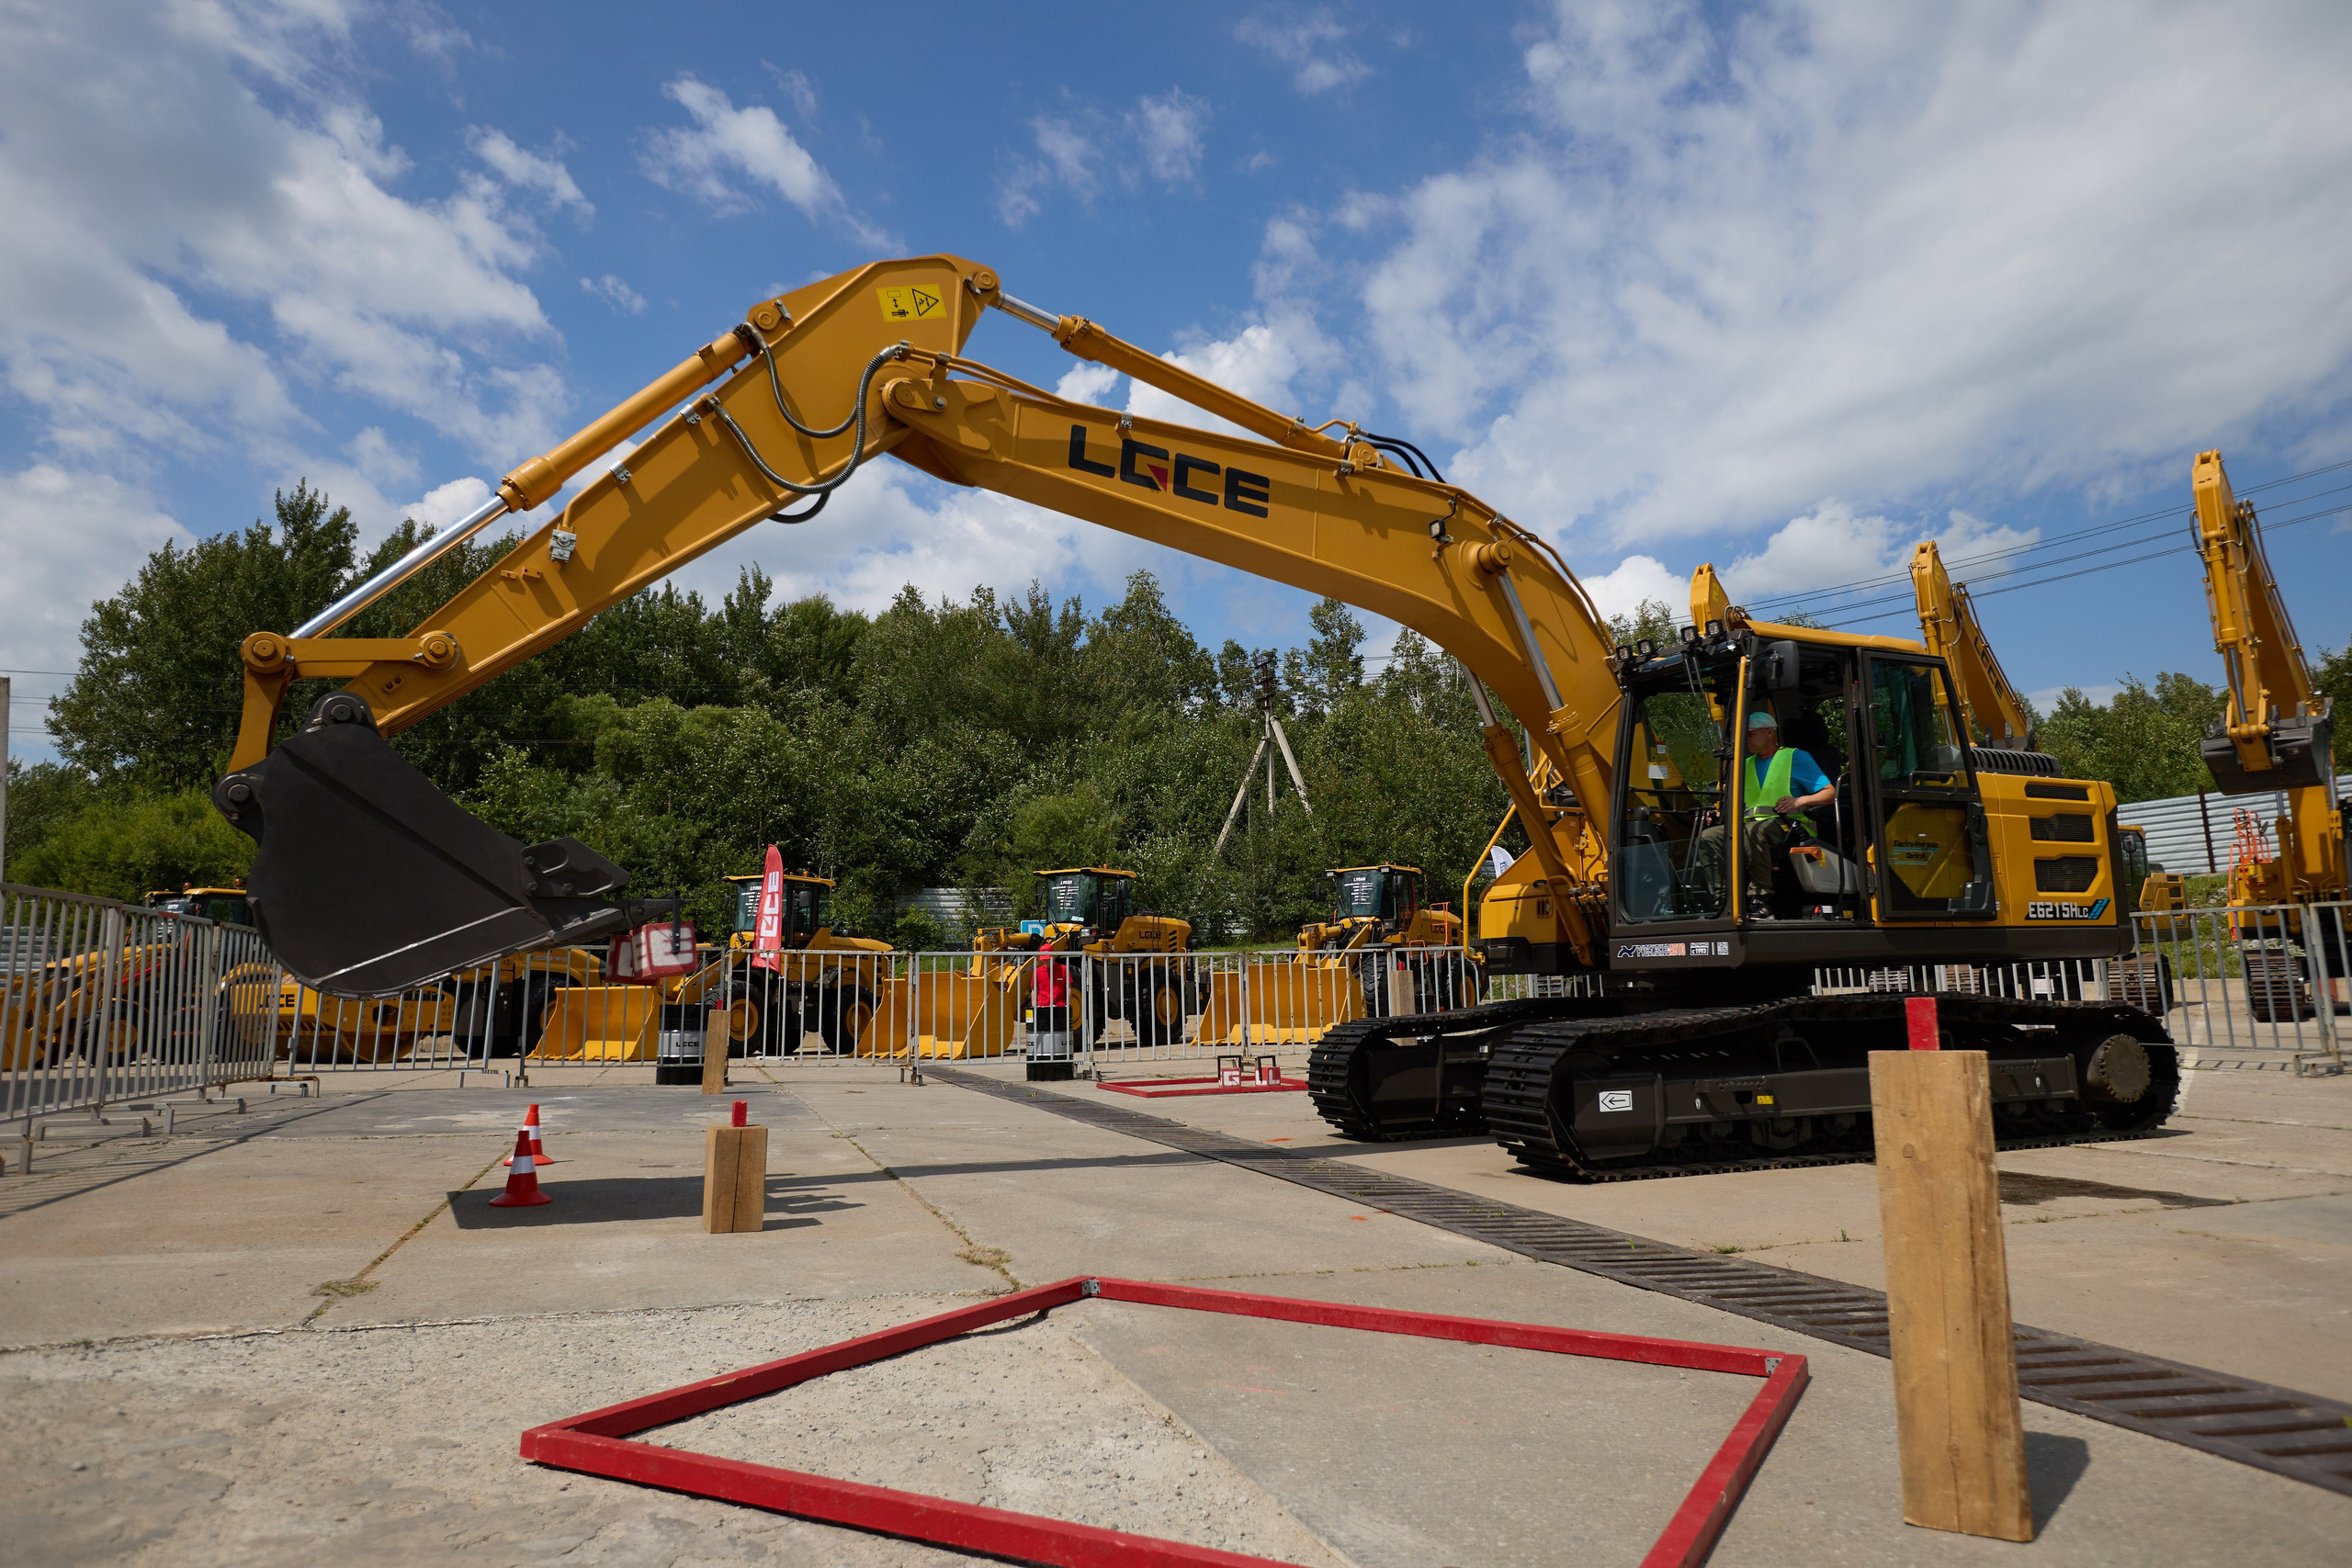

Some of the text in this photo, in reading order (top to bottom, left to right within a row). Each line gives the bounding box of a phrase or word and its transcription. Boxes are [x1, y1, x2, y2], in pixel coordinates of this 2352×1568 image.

[1069, 424, 1270, 518] LGCE
[1973, 636, 2003, 699] LGCE
[759, 871, 780, 958] LGCE
